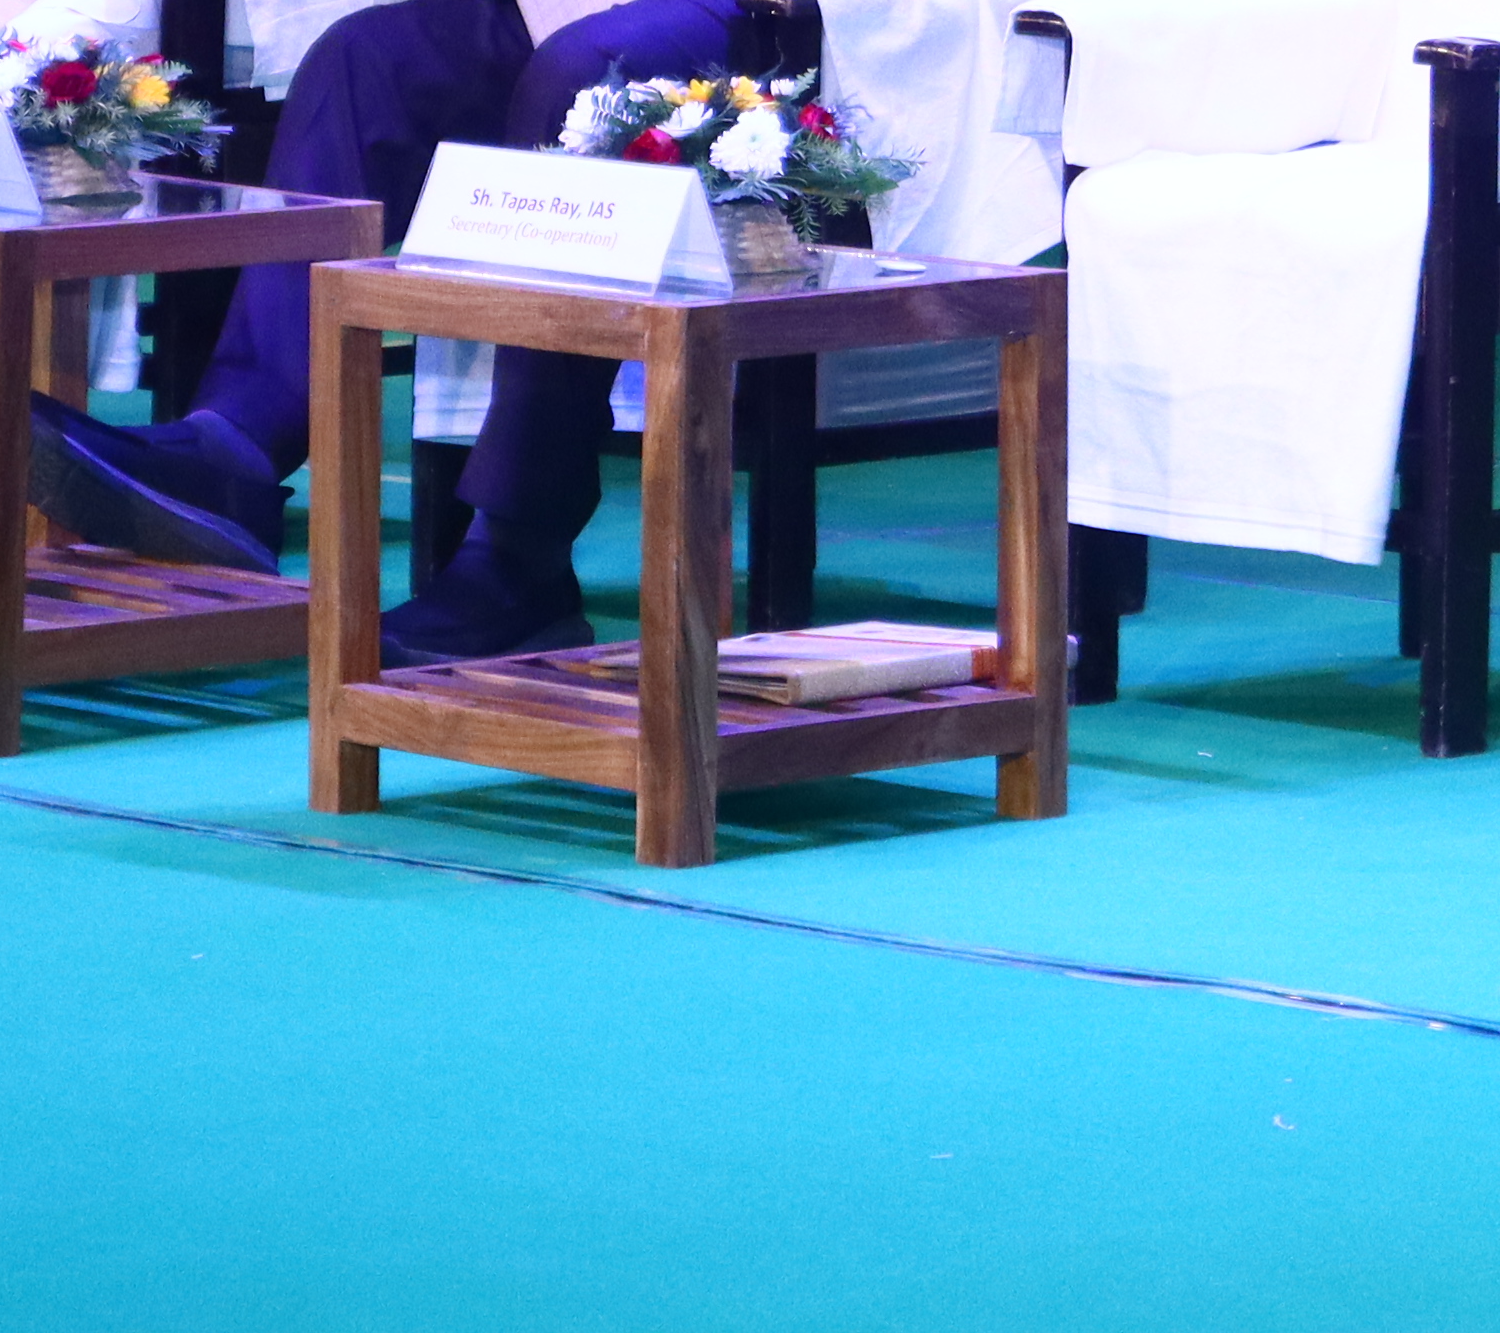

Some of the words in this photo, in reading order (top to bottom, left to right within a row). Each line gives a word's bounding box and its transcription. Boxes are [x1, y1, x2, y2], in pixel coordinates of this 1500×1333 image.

[469, 187, 494, 208] Sh.
[500, 190, 546, 214] Tapas
[549, 196, 582, 221] Ray,
[586, 200, 616, 220] IAS
[447, 215, 514, 241] Secretary
[514, 220, 619, 251] (Co-operation)
